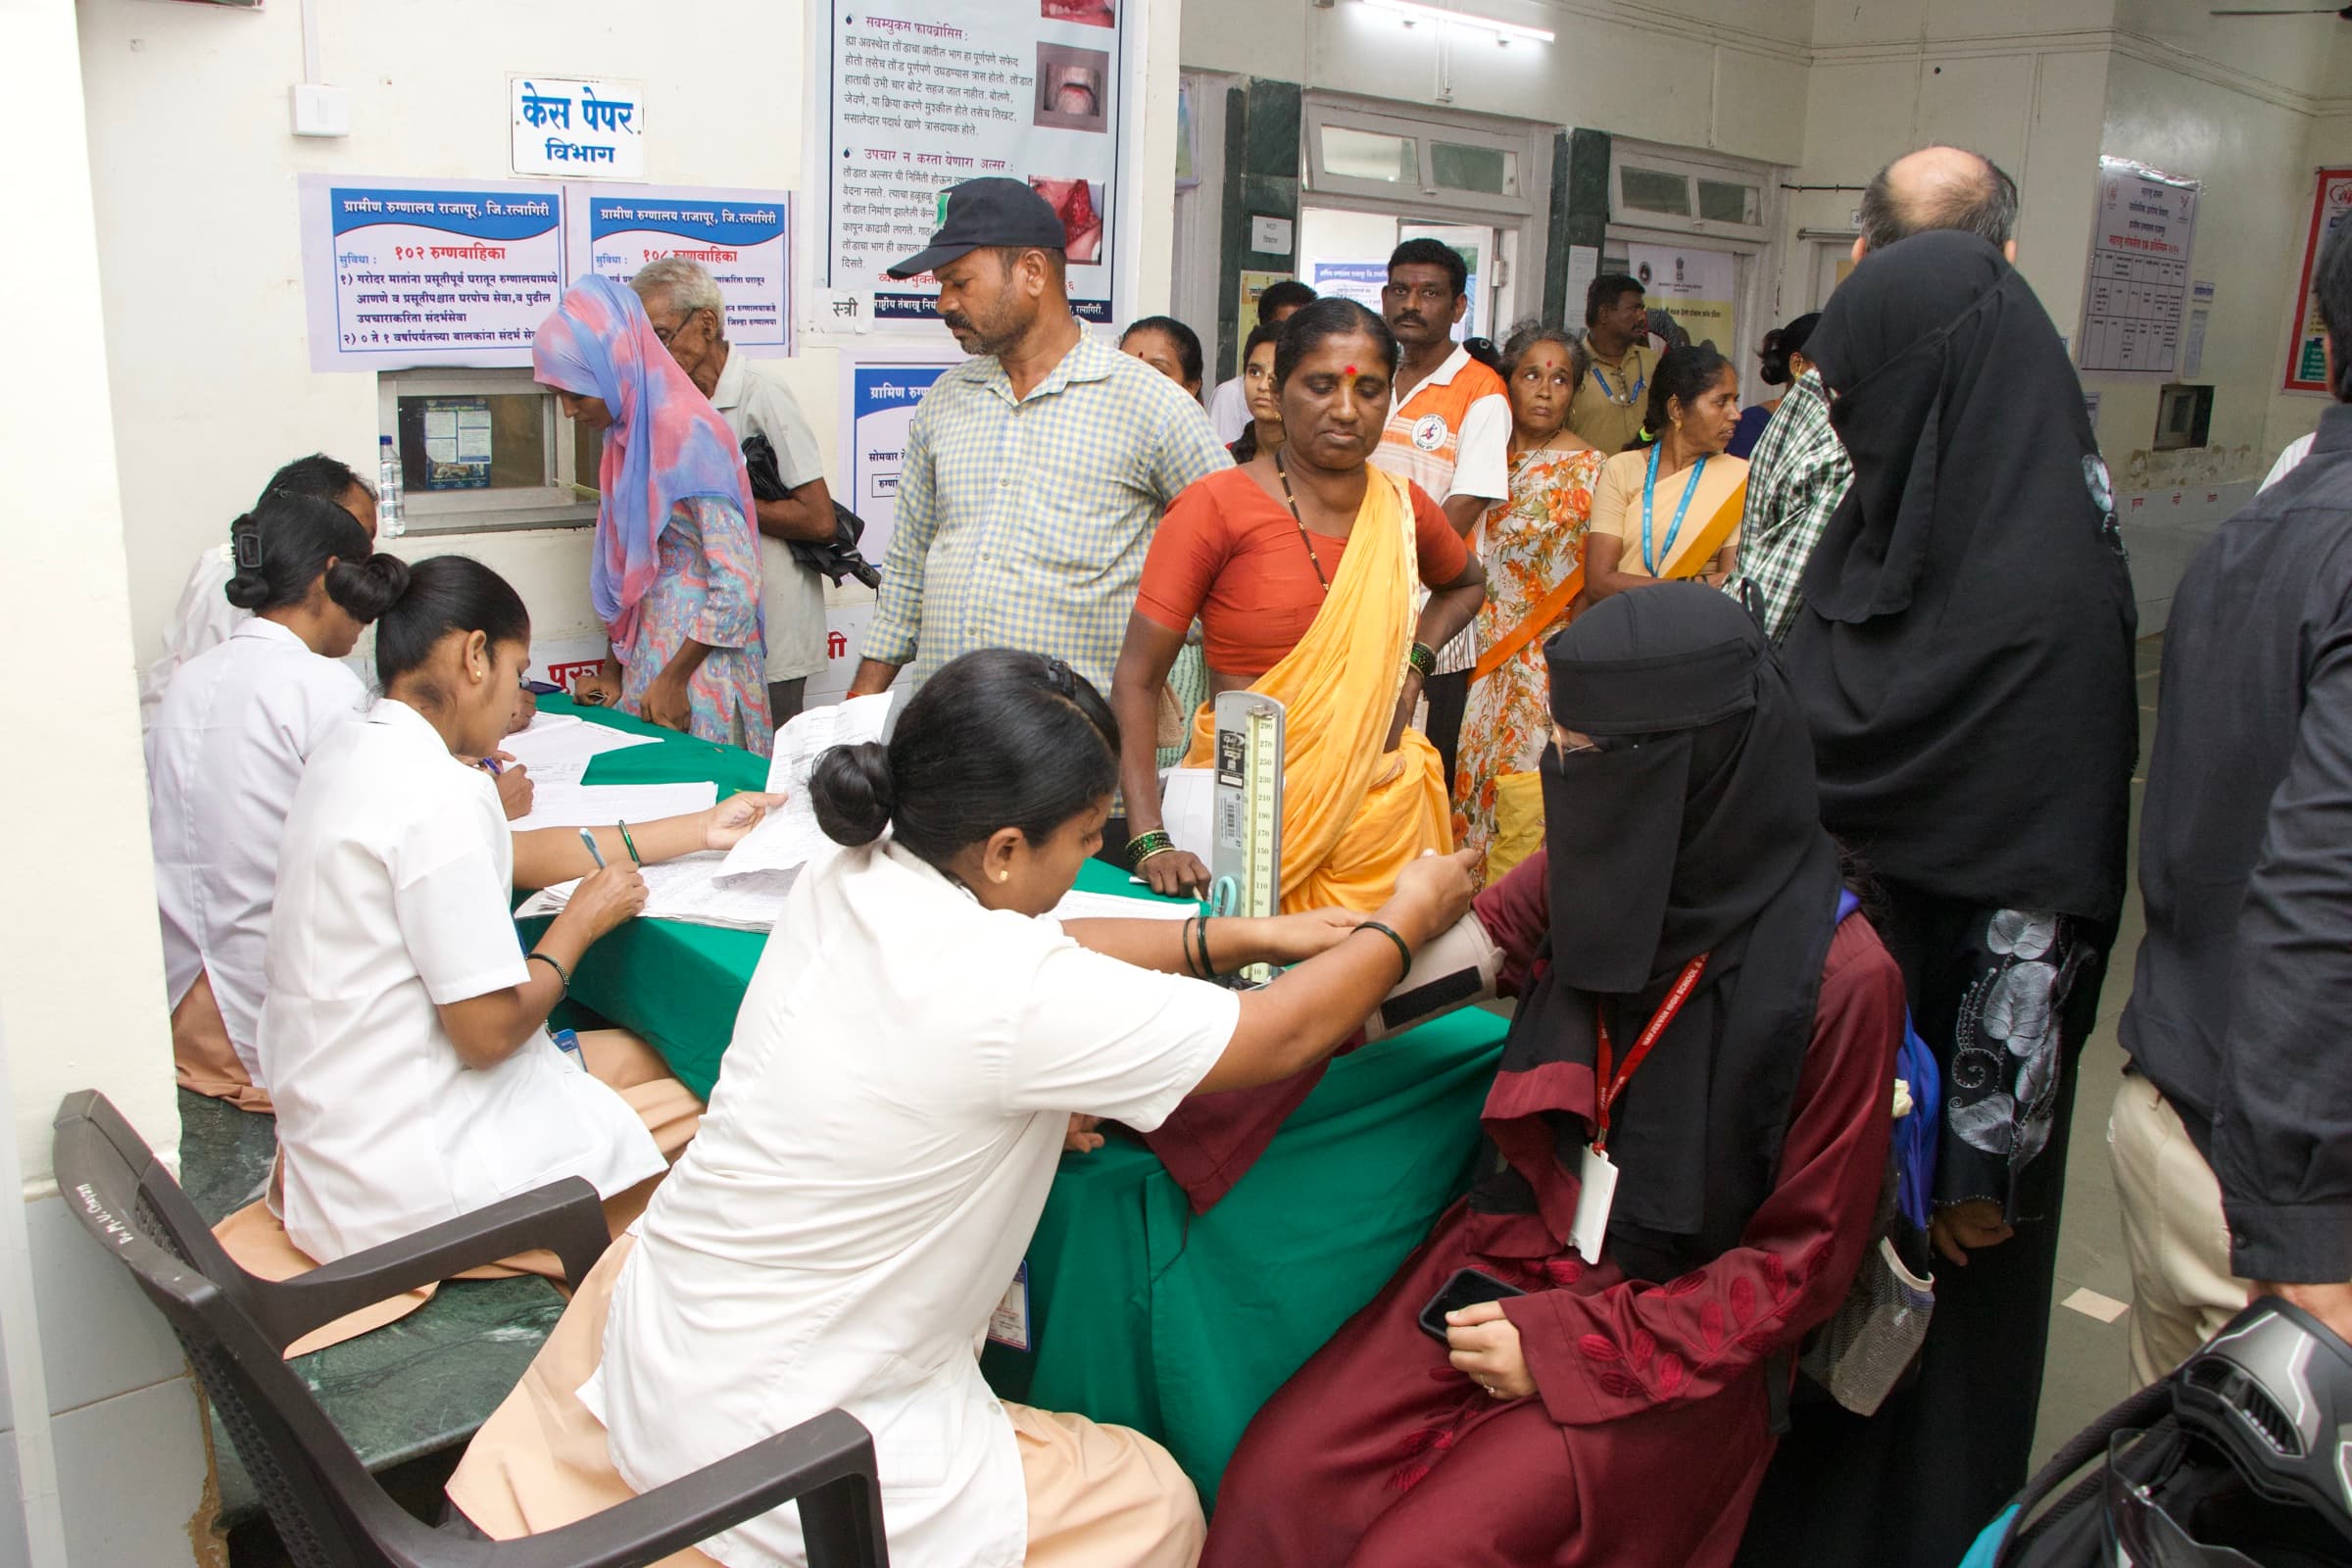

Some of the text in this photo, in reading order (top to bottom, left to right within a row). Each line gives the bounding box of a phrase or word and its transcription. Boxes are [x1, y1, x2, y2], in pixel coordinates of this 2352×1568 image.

[865, 55, 886, 69] तसेच
[521, 81, 633, 134] केस पेपर
[545, 137, 615, 163] विभाग
[864, 149, 897, 161] उपचार
[904, 151, 910, 163] न
[980, 159, 1005, 171] अल्सर
[870, 171, 892, 180] अल्सर
[843, 183, 861, 196] वेदना
[344, 197, 382, 214] ग्रामीण
[386, 201, 434, 215] रुग्णालय
[601, 206, 633, 220] ग्रामीण
[637, 211, 677, 221] रुग्णालय
[843, 223, 862, 235] कापून
[394, 242, 506, 261] १०२ रुग्णवाहिका
[871, 242, 884, 252] भाग
[886, 240, 894, 253] ही
[339, 252, 368, 269] सुविधा
[596, 254, 621, 268] सुविधा
[357, 273, 385, 284] गरोदर
[389, 271, 420, 284] मातांना
[467, 274, 496, 287] घरातून
[500, 271, 558, 284] रुग्णालयामध्ये
[357, 291, 388, 304] आणणे
[392, 295, 400, 304] व
[459, 291, 489, 304] घरपोच
[526, 290, 551, 307] पुढील
[357, 309, 466, 323] उपचाराकरिता संदर्भसेवा
[833, 298, 858, 318] स्त्री
[371, 329, 379, 343] ते
[454, 329, 495, 342] बालकांना
[499, 329, 520, 341] संदर्भ
[870, 382, 905, 400] ग्रामिण
[868, 449, 899, 463] सोमवार
[1676, 968, 1699, 996] SCHOOL
